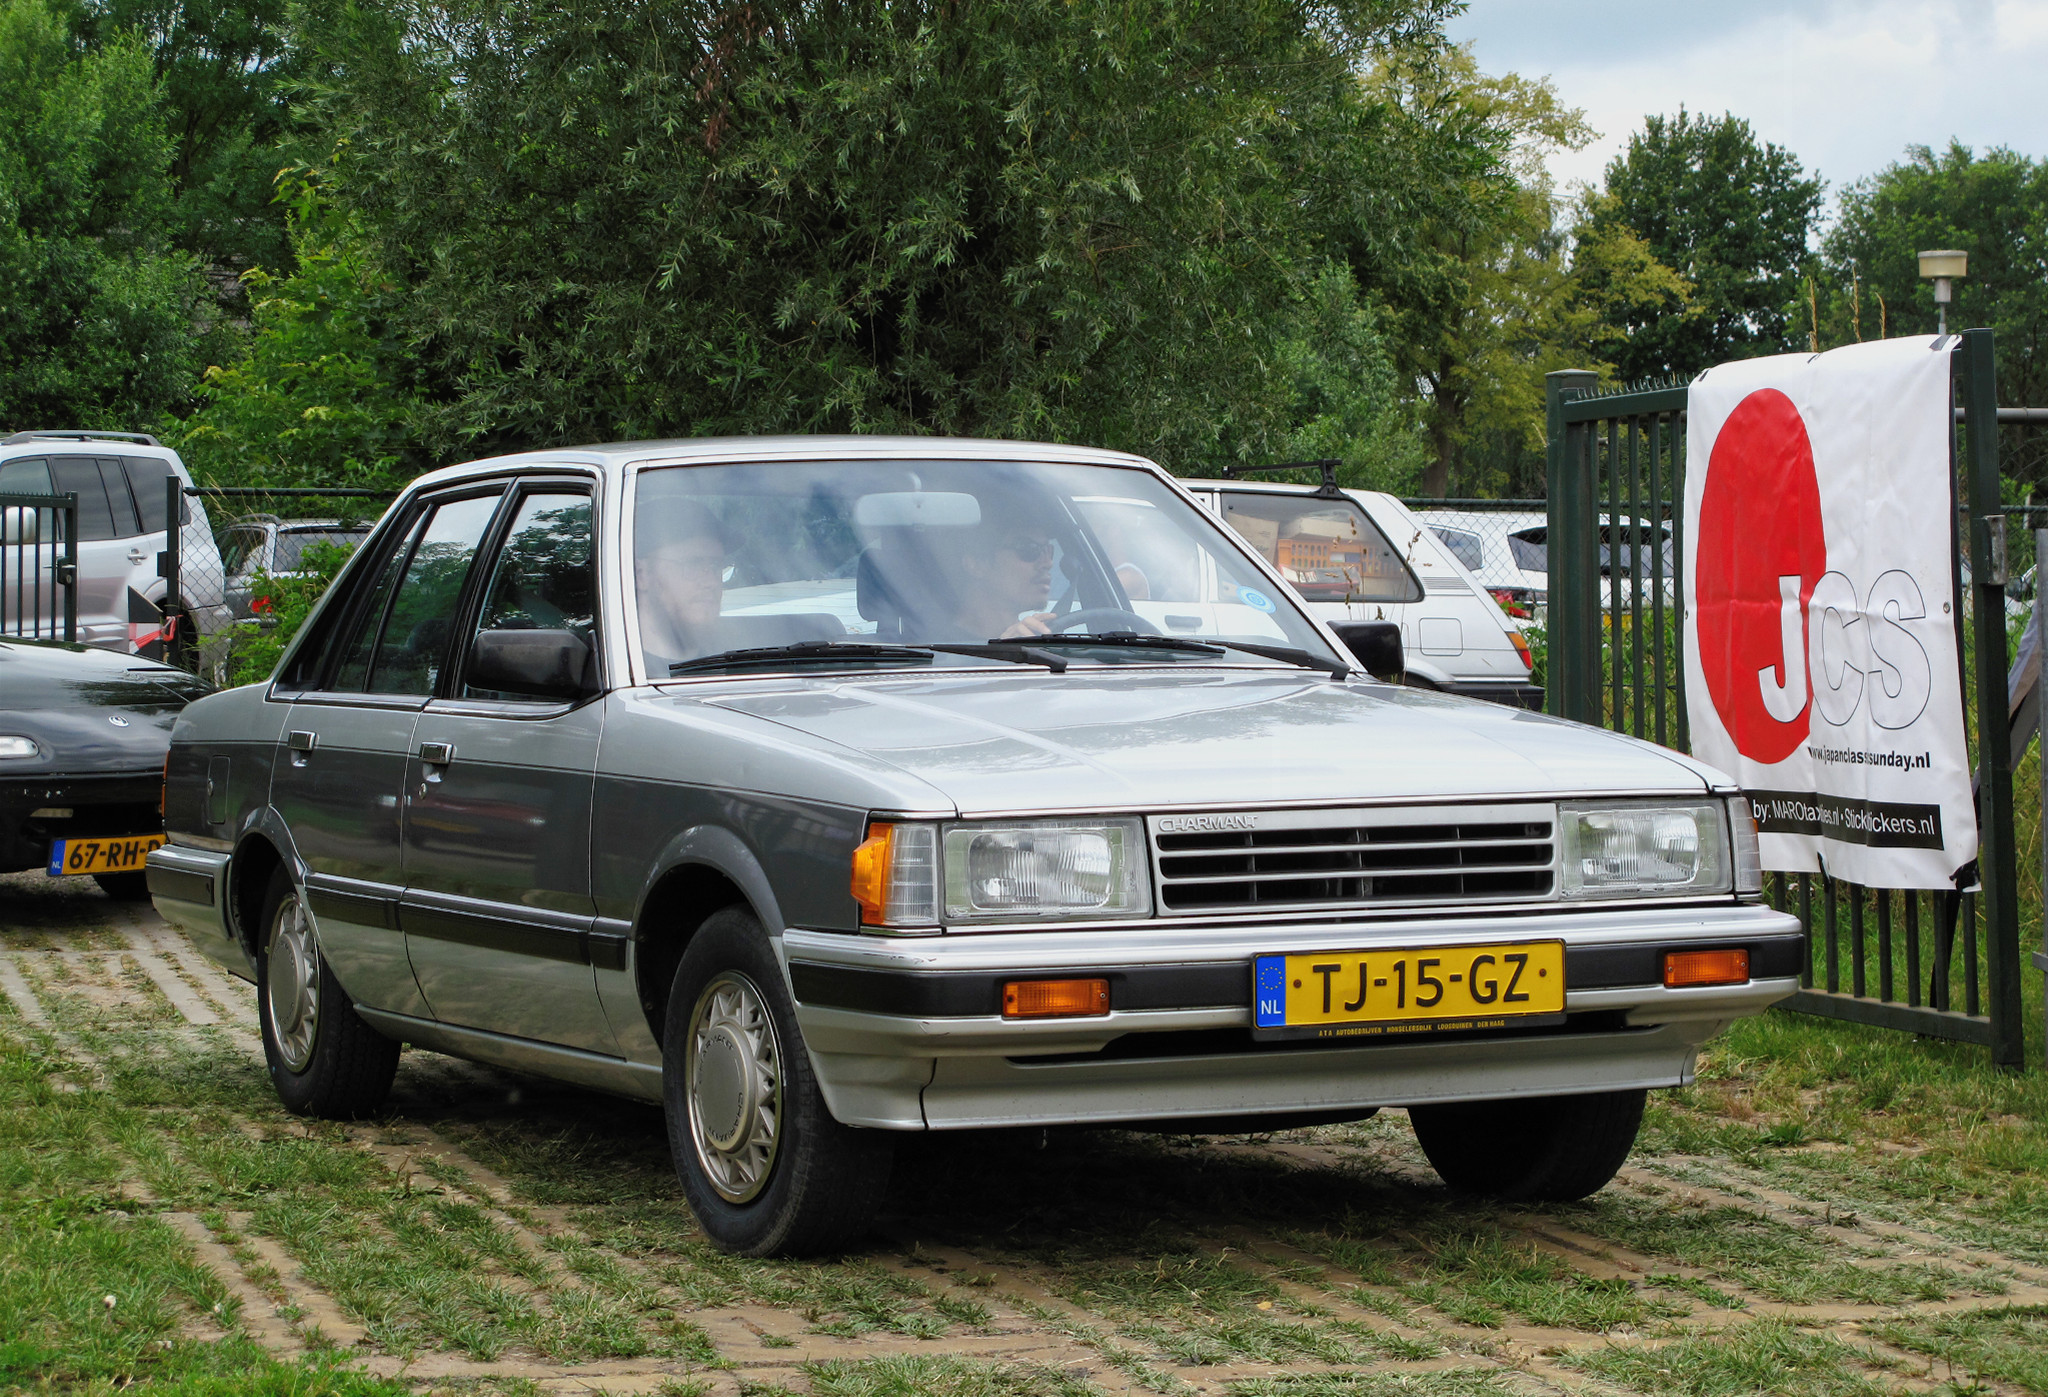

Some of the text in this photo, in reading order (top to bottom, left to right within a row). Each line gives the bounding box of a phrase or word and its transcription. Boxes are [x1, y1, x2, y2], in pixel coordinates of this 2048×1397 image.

[1758, 569, 1931, 730] JCS
[1752, 799, 1771, 823] by:
[1159, 815, 1258, 832] CHARMANT
[51, 861, 61, 869] NL
[1312, 953, 1530, 1013] TJ-15-GZ
[1261, 999, 1282, 1015] NL
